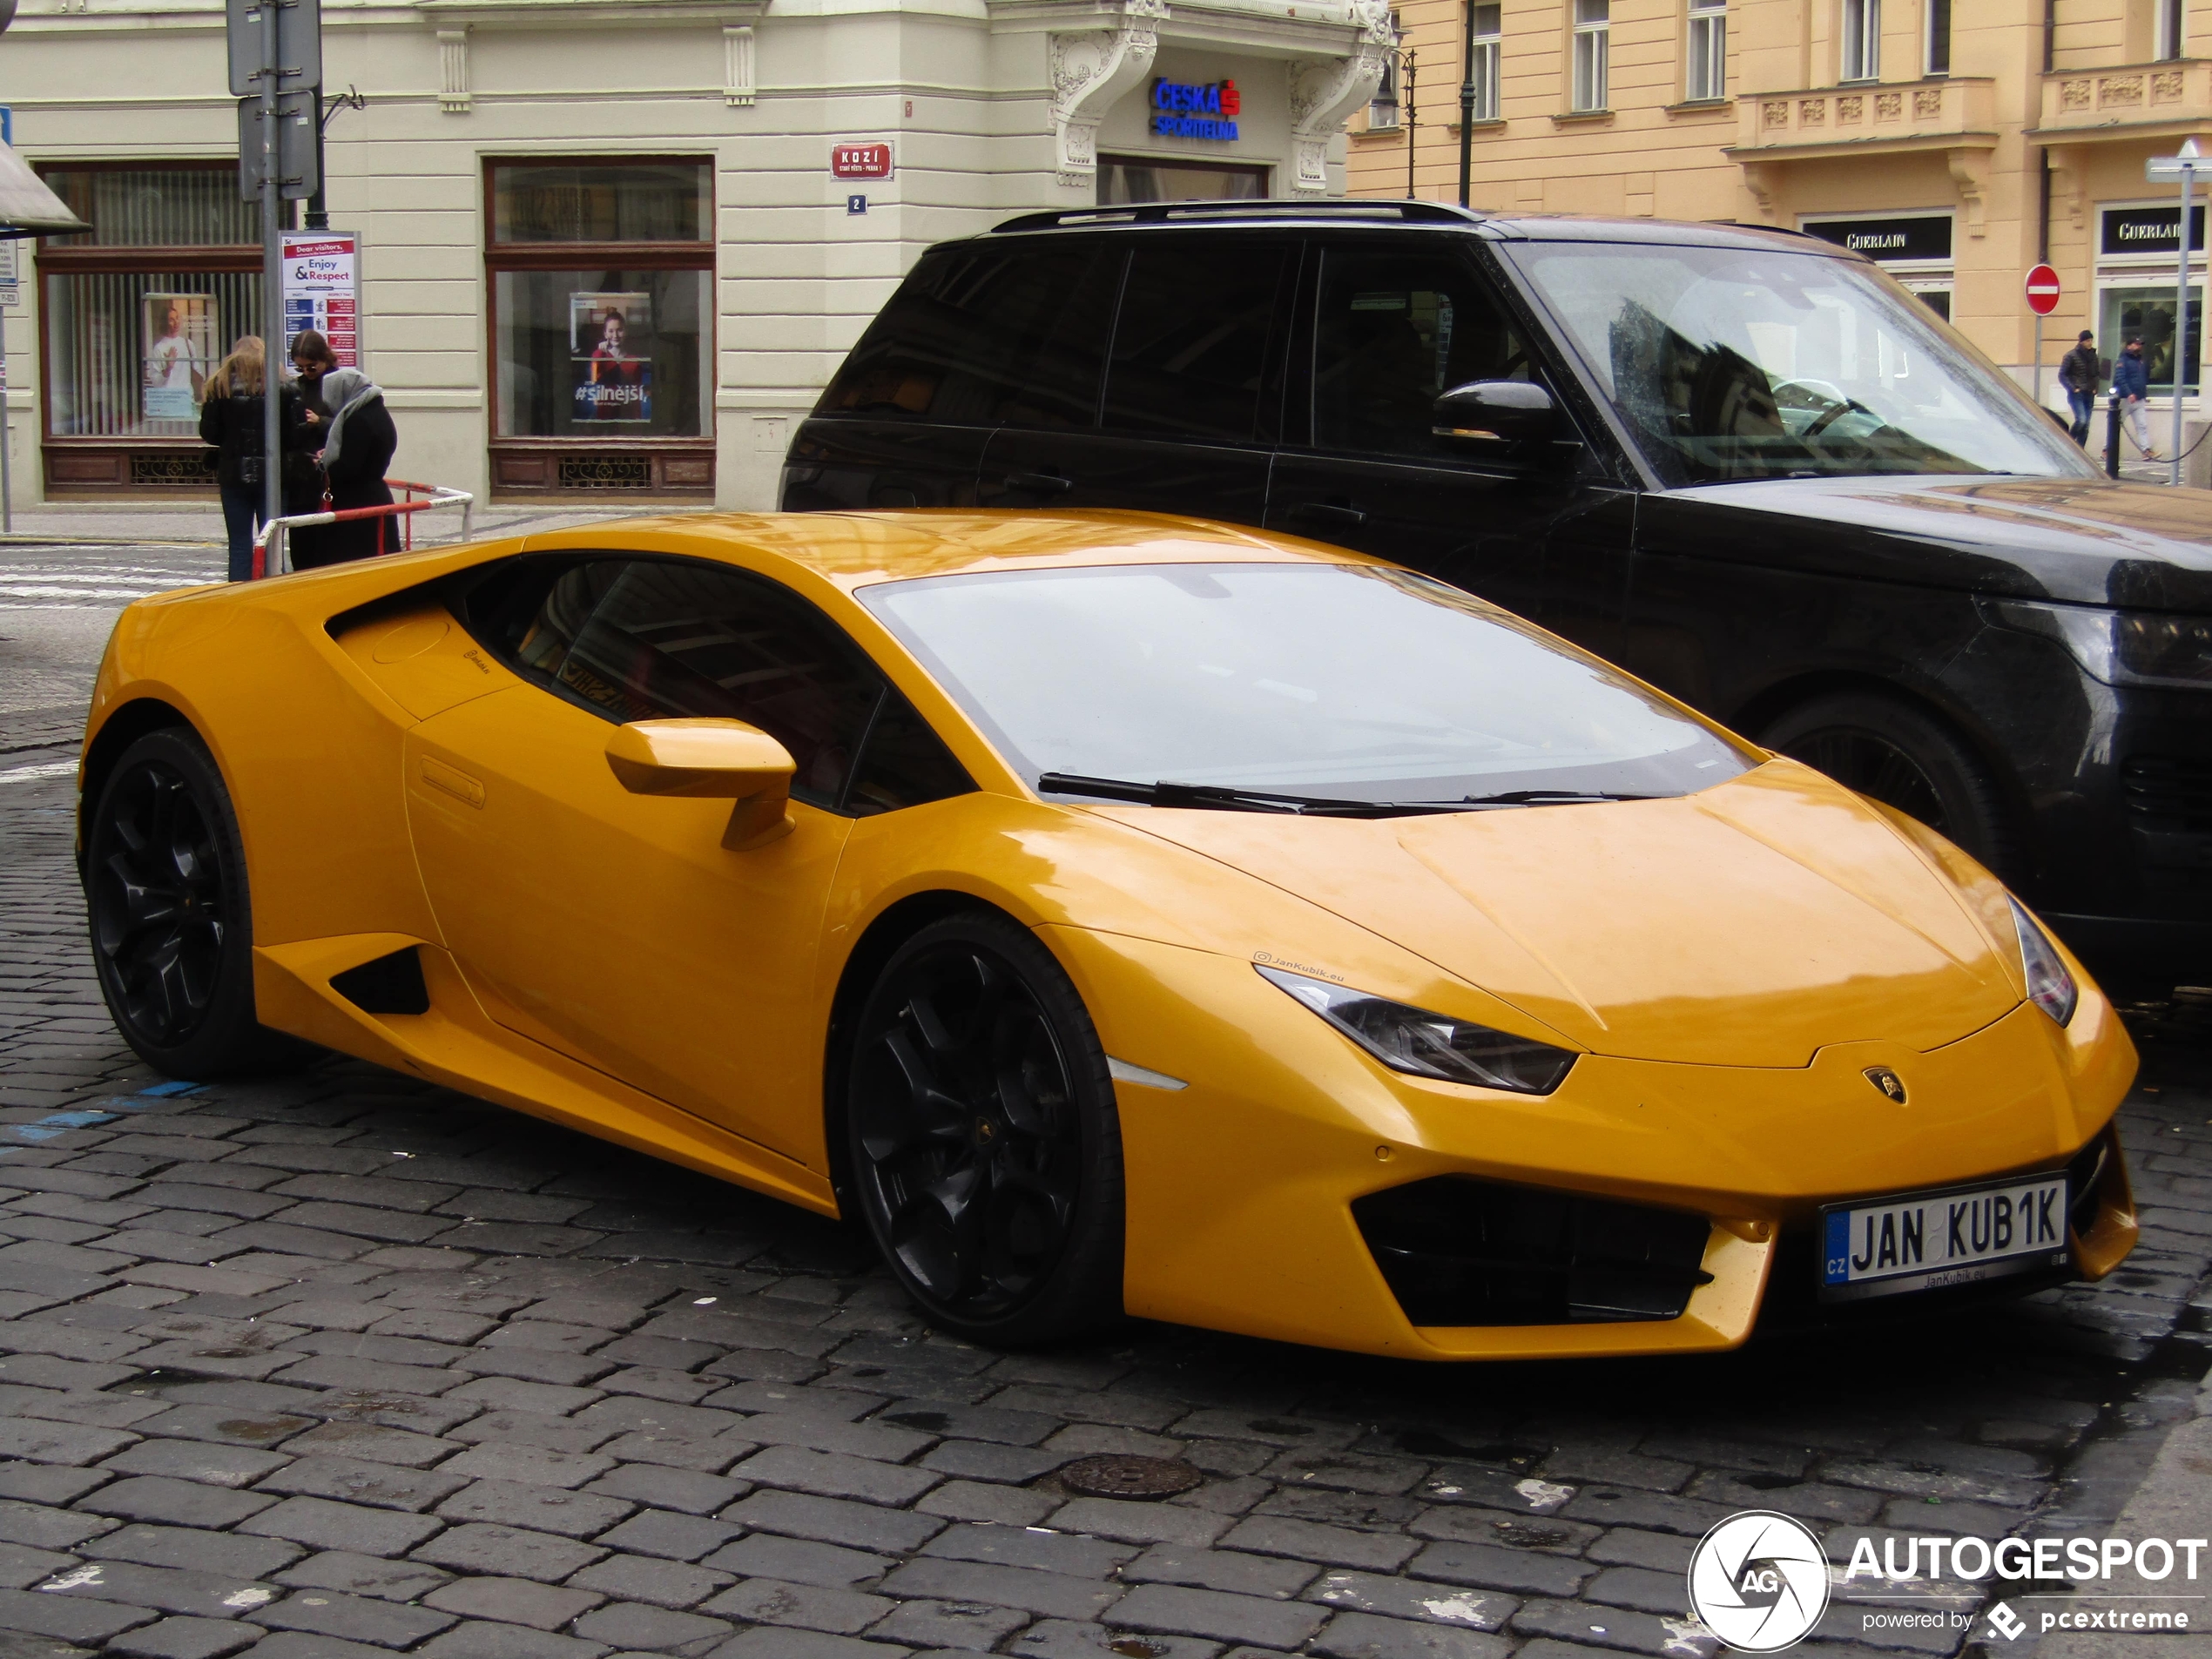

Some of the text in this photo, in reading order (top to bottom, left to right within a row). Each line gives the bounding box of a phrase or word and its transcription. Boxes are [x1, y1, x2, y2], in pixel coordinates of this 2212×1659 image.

[1156, 78, 1221, 114] ČESKÁ
[1156, 113, 1239, 141] SPOŘITELNA
[841, 150, 878, 163] KOZÍ
[853, 199, 860, 209] 2
[1846, 233, 1905, 249] GUERLAIN
[295, 266, 349, 282] & Respect
[308, 260, 337, 271] Enjoy
[575, 384, 647, 405] #silnější,
[1272, 957, 1345, 982] JanKubik.eu
[1851, 1188, 2058, 1271] JAN KUB1K
[1827, 1258, 1845, 1276] CZ
[1924, 1268, 1986, 1289] JanKubik.eu
